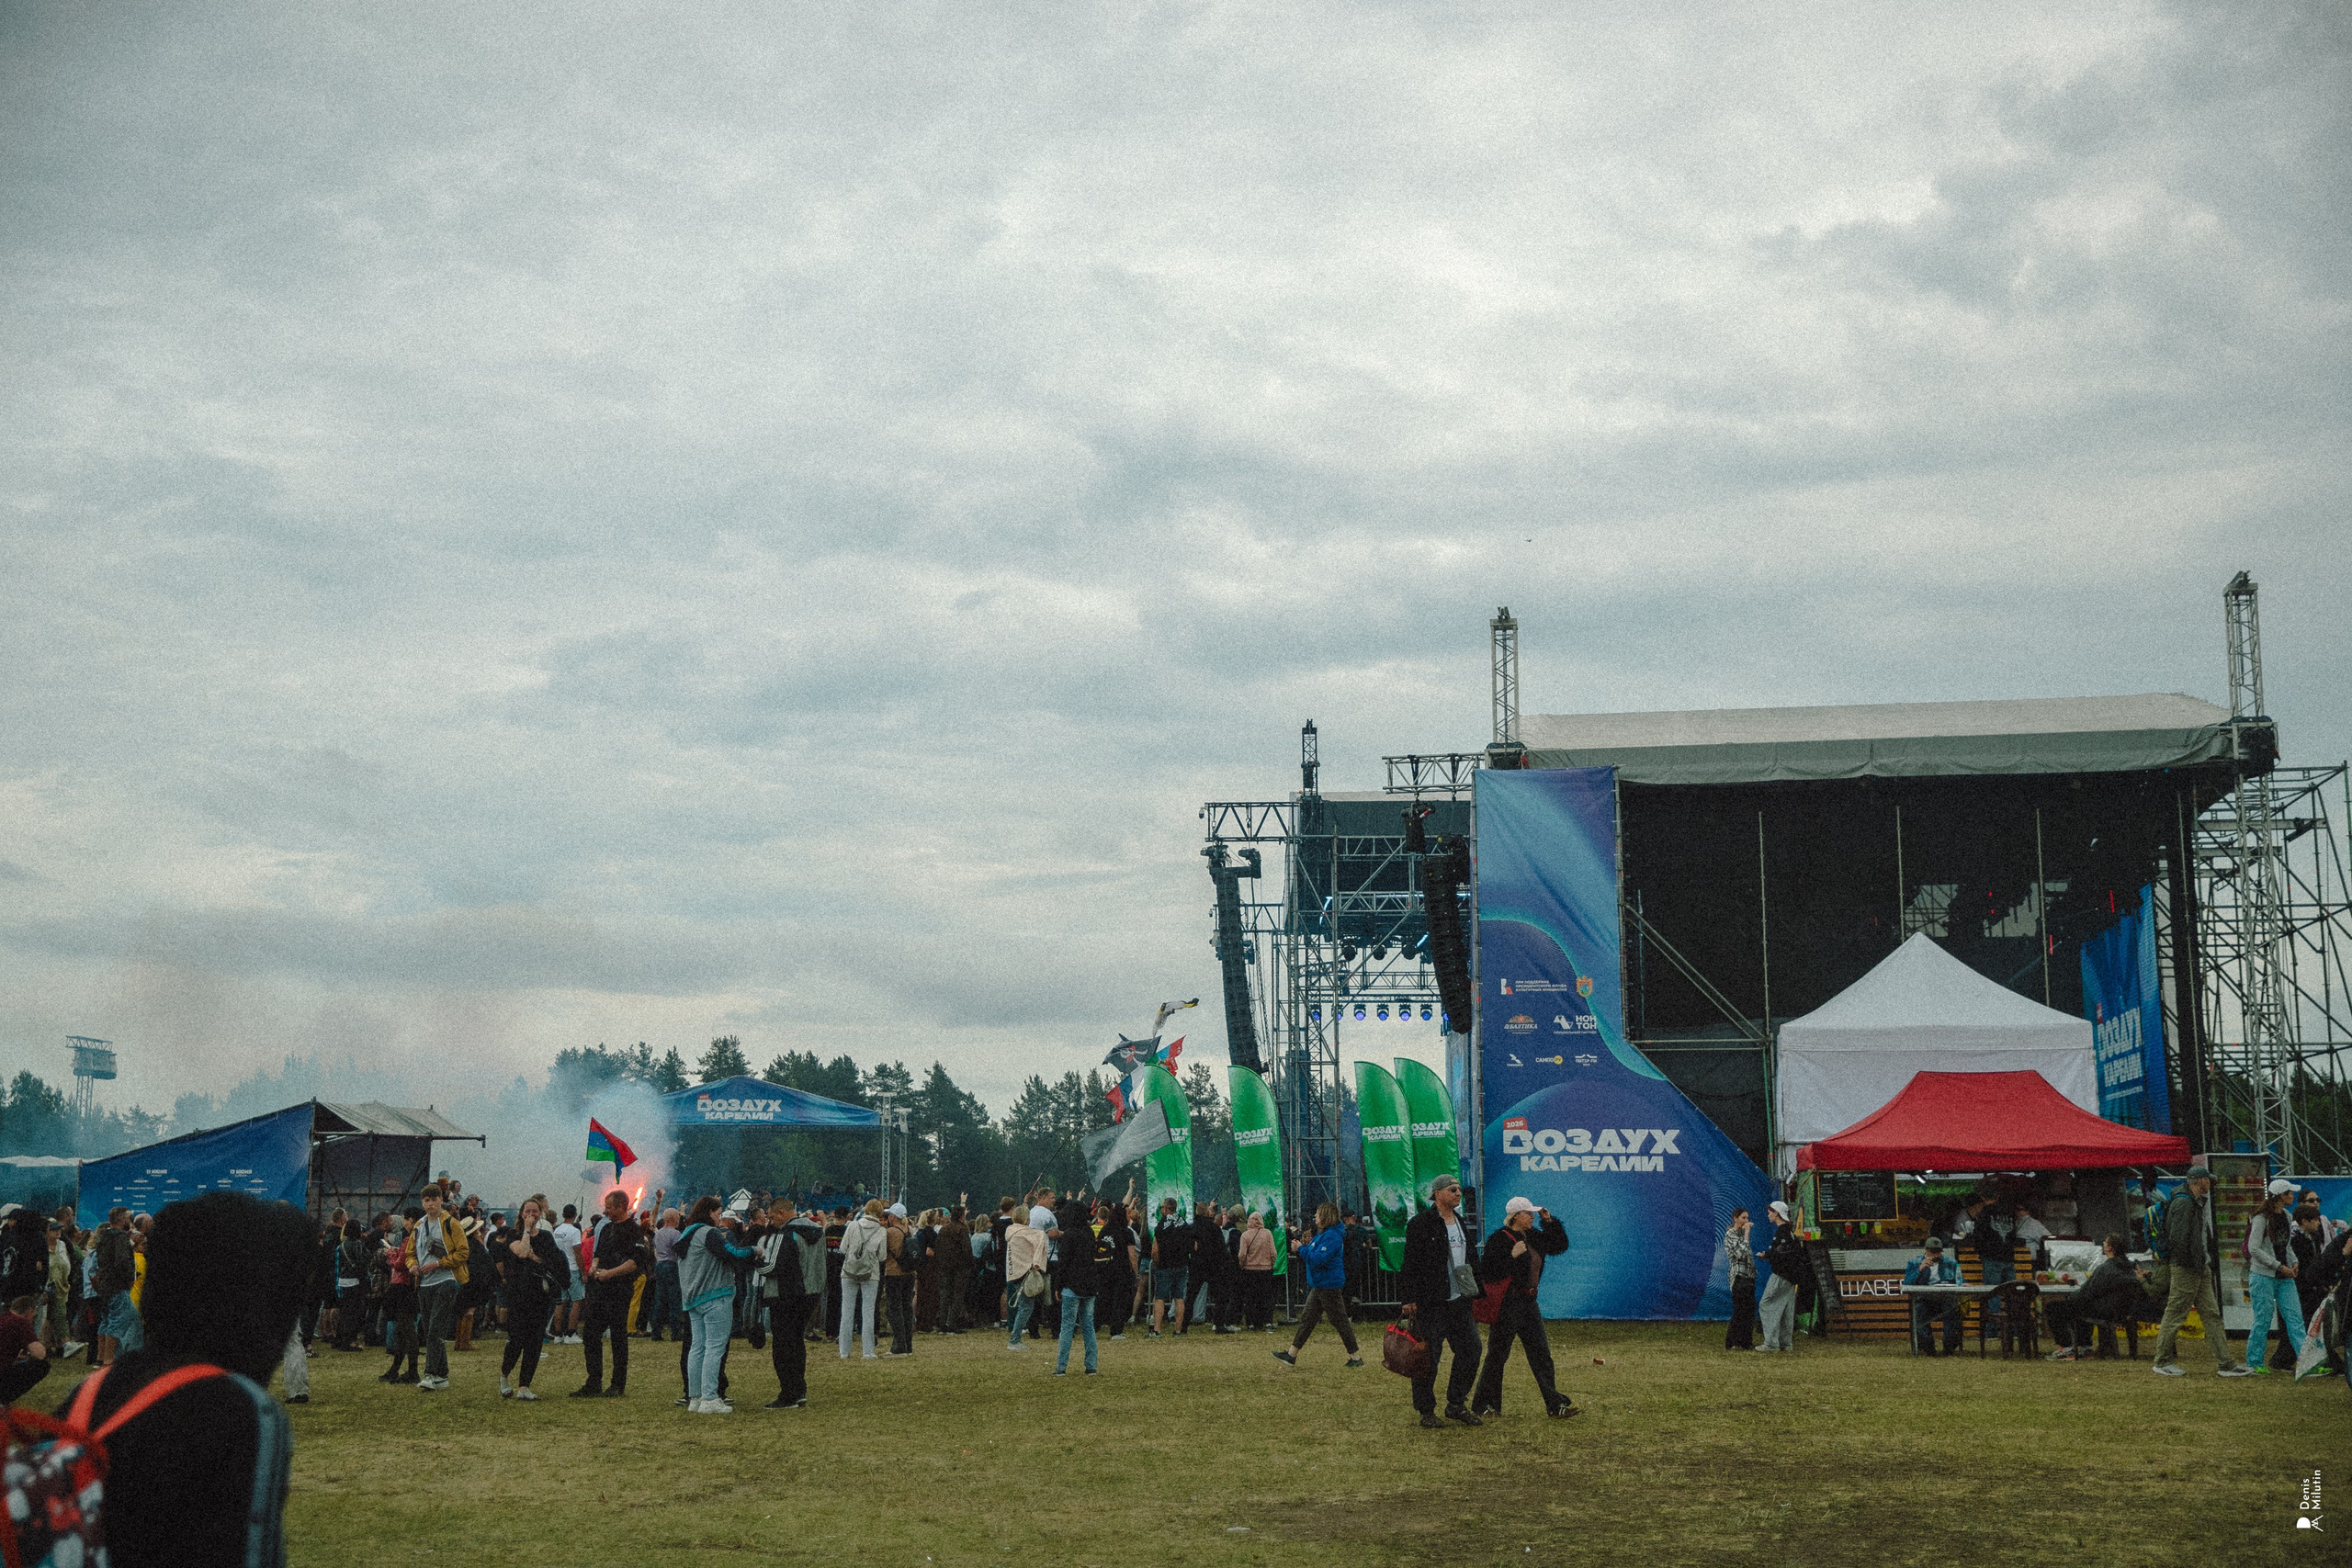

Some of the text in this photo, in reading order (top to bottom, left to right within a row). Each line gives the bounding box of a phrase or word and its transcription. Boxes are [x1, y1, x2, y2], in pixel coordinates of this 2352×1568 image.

[696, 1099, 782, 1112] ВОЗДУХ
[705, 1111, 774, 1120] КАРЕЛИИ
[1362, 1125, 1405, 1136] ВОЗДУХ
[1411, 1122, 1451, 1132] ОЗДУХ
[1234, 1127, 1274, 1141] ВОЗДУХ
[1239, 1136, 1271, 1145] КАРЕЛИИ
[1503, 1129, 1680, 1155] ВОЗДУХ
[1520, 1156, 1664, 1172] КАРЕЛИИ
